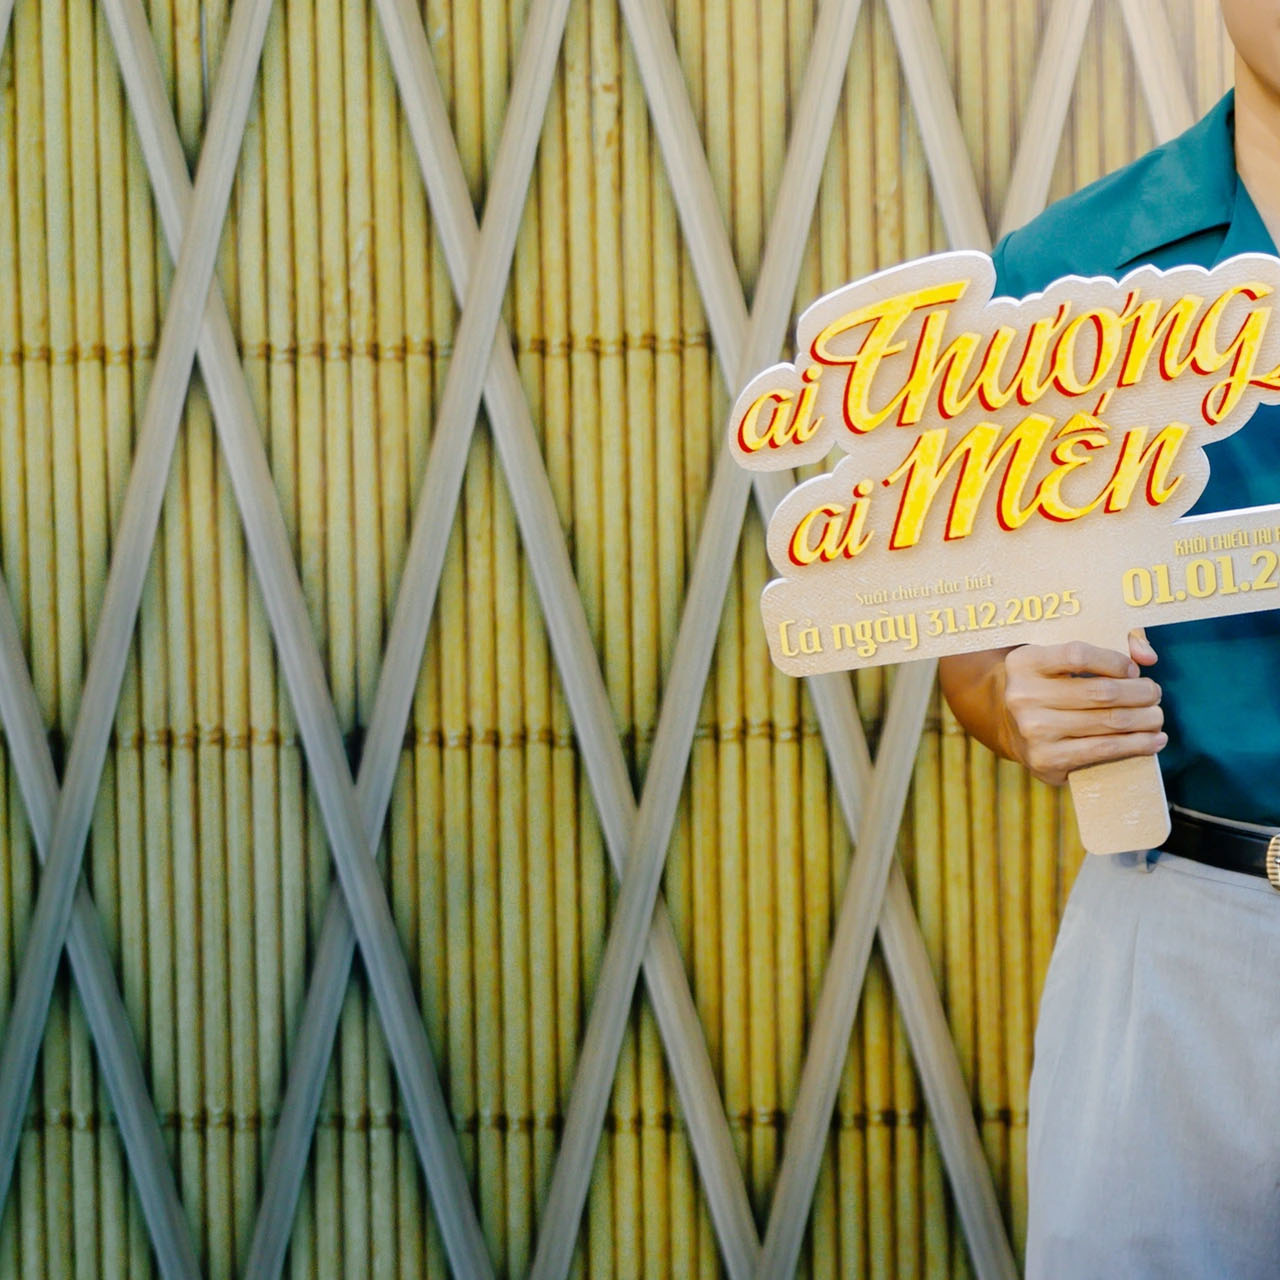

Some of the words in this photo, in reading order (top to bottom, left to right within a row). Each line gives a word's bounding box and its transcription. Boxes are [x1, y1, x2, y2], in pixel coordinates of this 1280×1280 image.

[737, 364, 825, 454] ai
[788, 479, 875, 567] ai
[778, 619, 824, 658] Cả
[833, 610, 919, 658] ngày
[925, 589, 1081, 637] 31.12.2025
